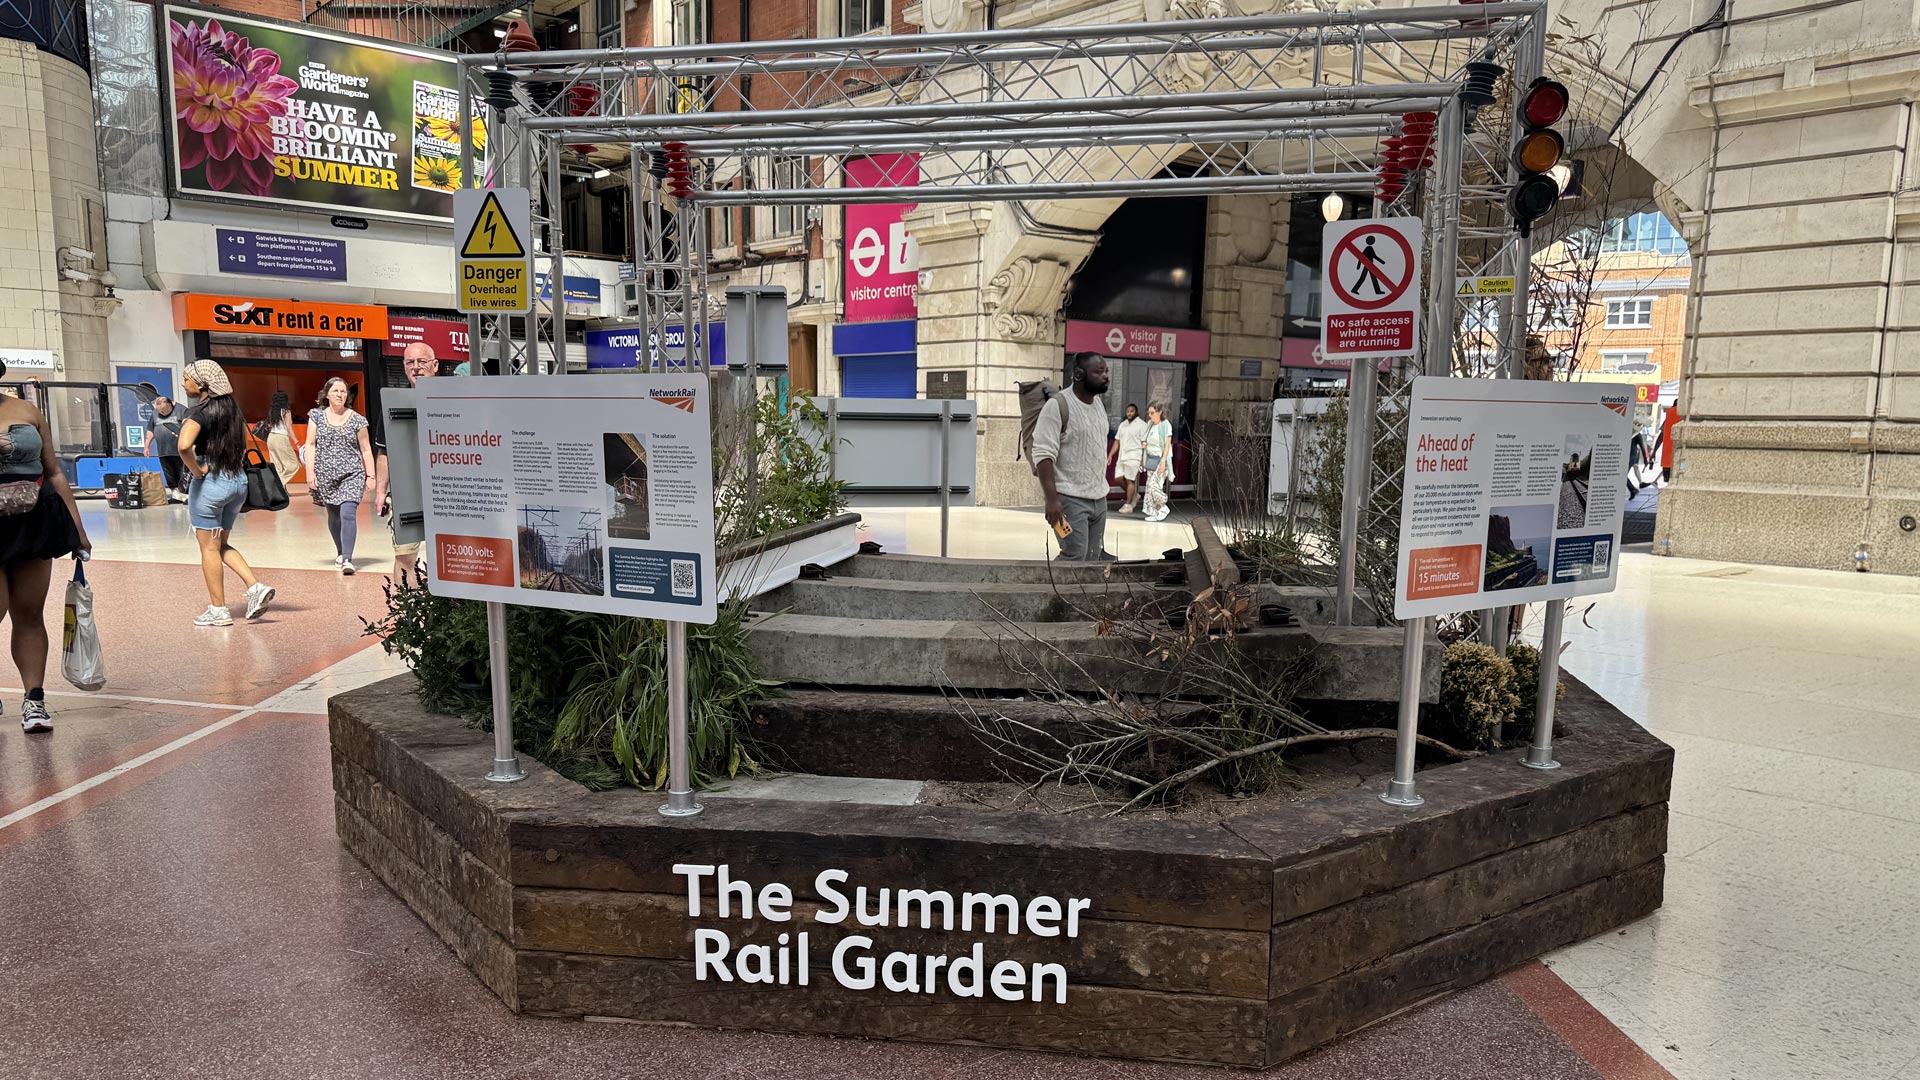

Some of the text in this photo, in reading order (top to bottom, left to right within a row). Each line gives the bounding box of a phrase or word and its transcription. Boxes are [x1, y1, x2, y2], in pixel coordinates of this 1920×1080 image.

[298, 65, 368, 88] Gardeners'
[299, 77, 369, 99] World magazine
[286, 98, 382, 130] HAVE A
[416, 102, 456, 122] World
[271, 115, 397, 150] BLOOMIN'
[272, 136, 398, 169] BRILLIANT
[273, 155, 400, 191] SUMMER
[270, 243, 296, 251] platforms
[278, 236, 298, 245] Express
[320, 240, 337, 248] depart
[257, 260, 275, 268] depart
[290, 263, 315, 271] platforms
[312, 257, 333, 265] Gatwick
[464, 264, 522, 283] Danger
[469, 284, 517, 294] Overhead
[850, 282, 918, 301] visitor centre
[470, 298, 517, 307] live wires
[277, 311, 315, 330] rent
[319, 315, 330, 330] a
[335, 316, 364, 332] car
[1330, 316, 1410, 328] No safe access
[1130, 330, 1157, 341] visitor
[1339, 326, 1400, 338] while trains
[608, 335, 639, 348] VICTORIA
[1129, 343, 1157, 354] centre
[1339, 337, 1400, 348] are running
[649, 388, 696, 397] NetworkRail
[1600, 395, 1629, 403] NetworkRail
[428, 429, 502, 447] Lines under
[1417, 432, 1475, 452] Ahead of
[430, 452, 482, 468] pressure
[1416, 453, 1468, 473] the heat
[446, 544, 494, 558] 25,000 volts
[1419, 570, 1460, 583] 15 minutes
[672, 864, 1091, 938] The Summer
[694, 928, 1068, 1005] Rail Garden
